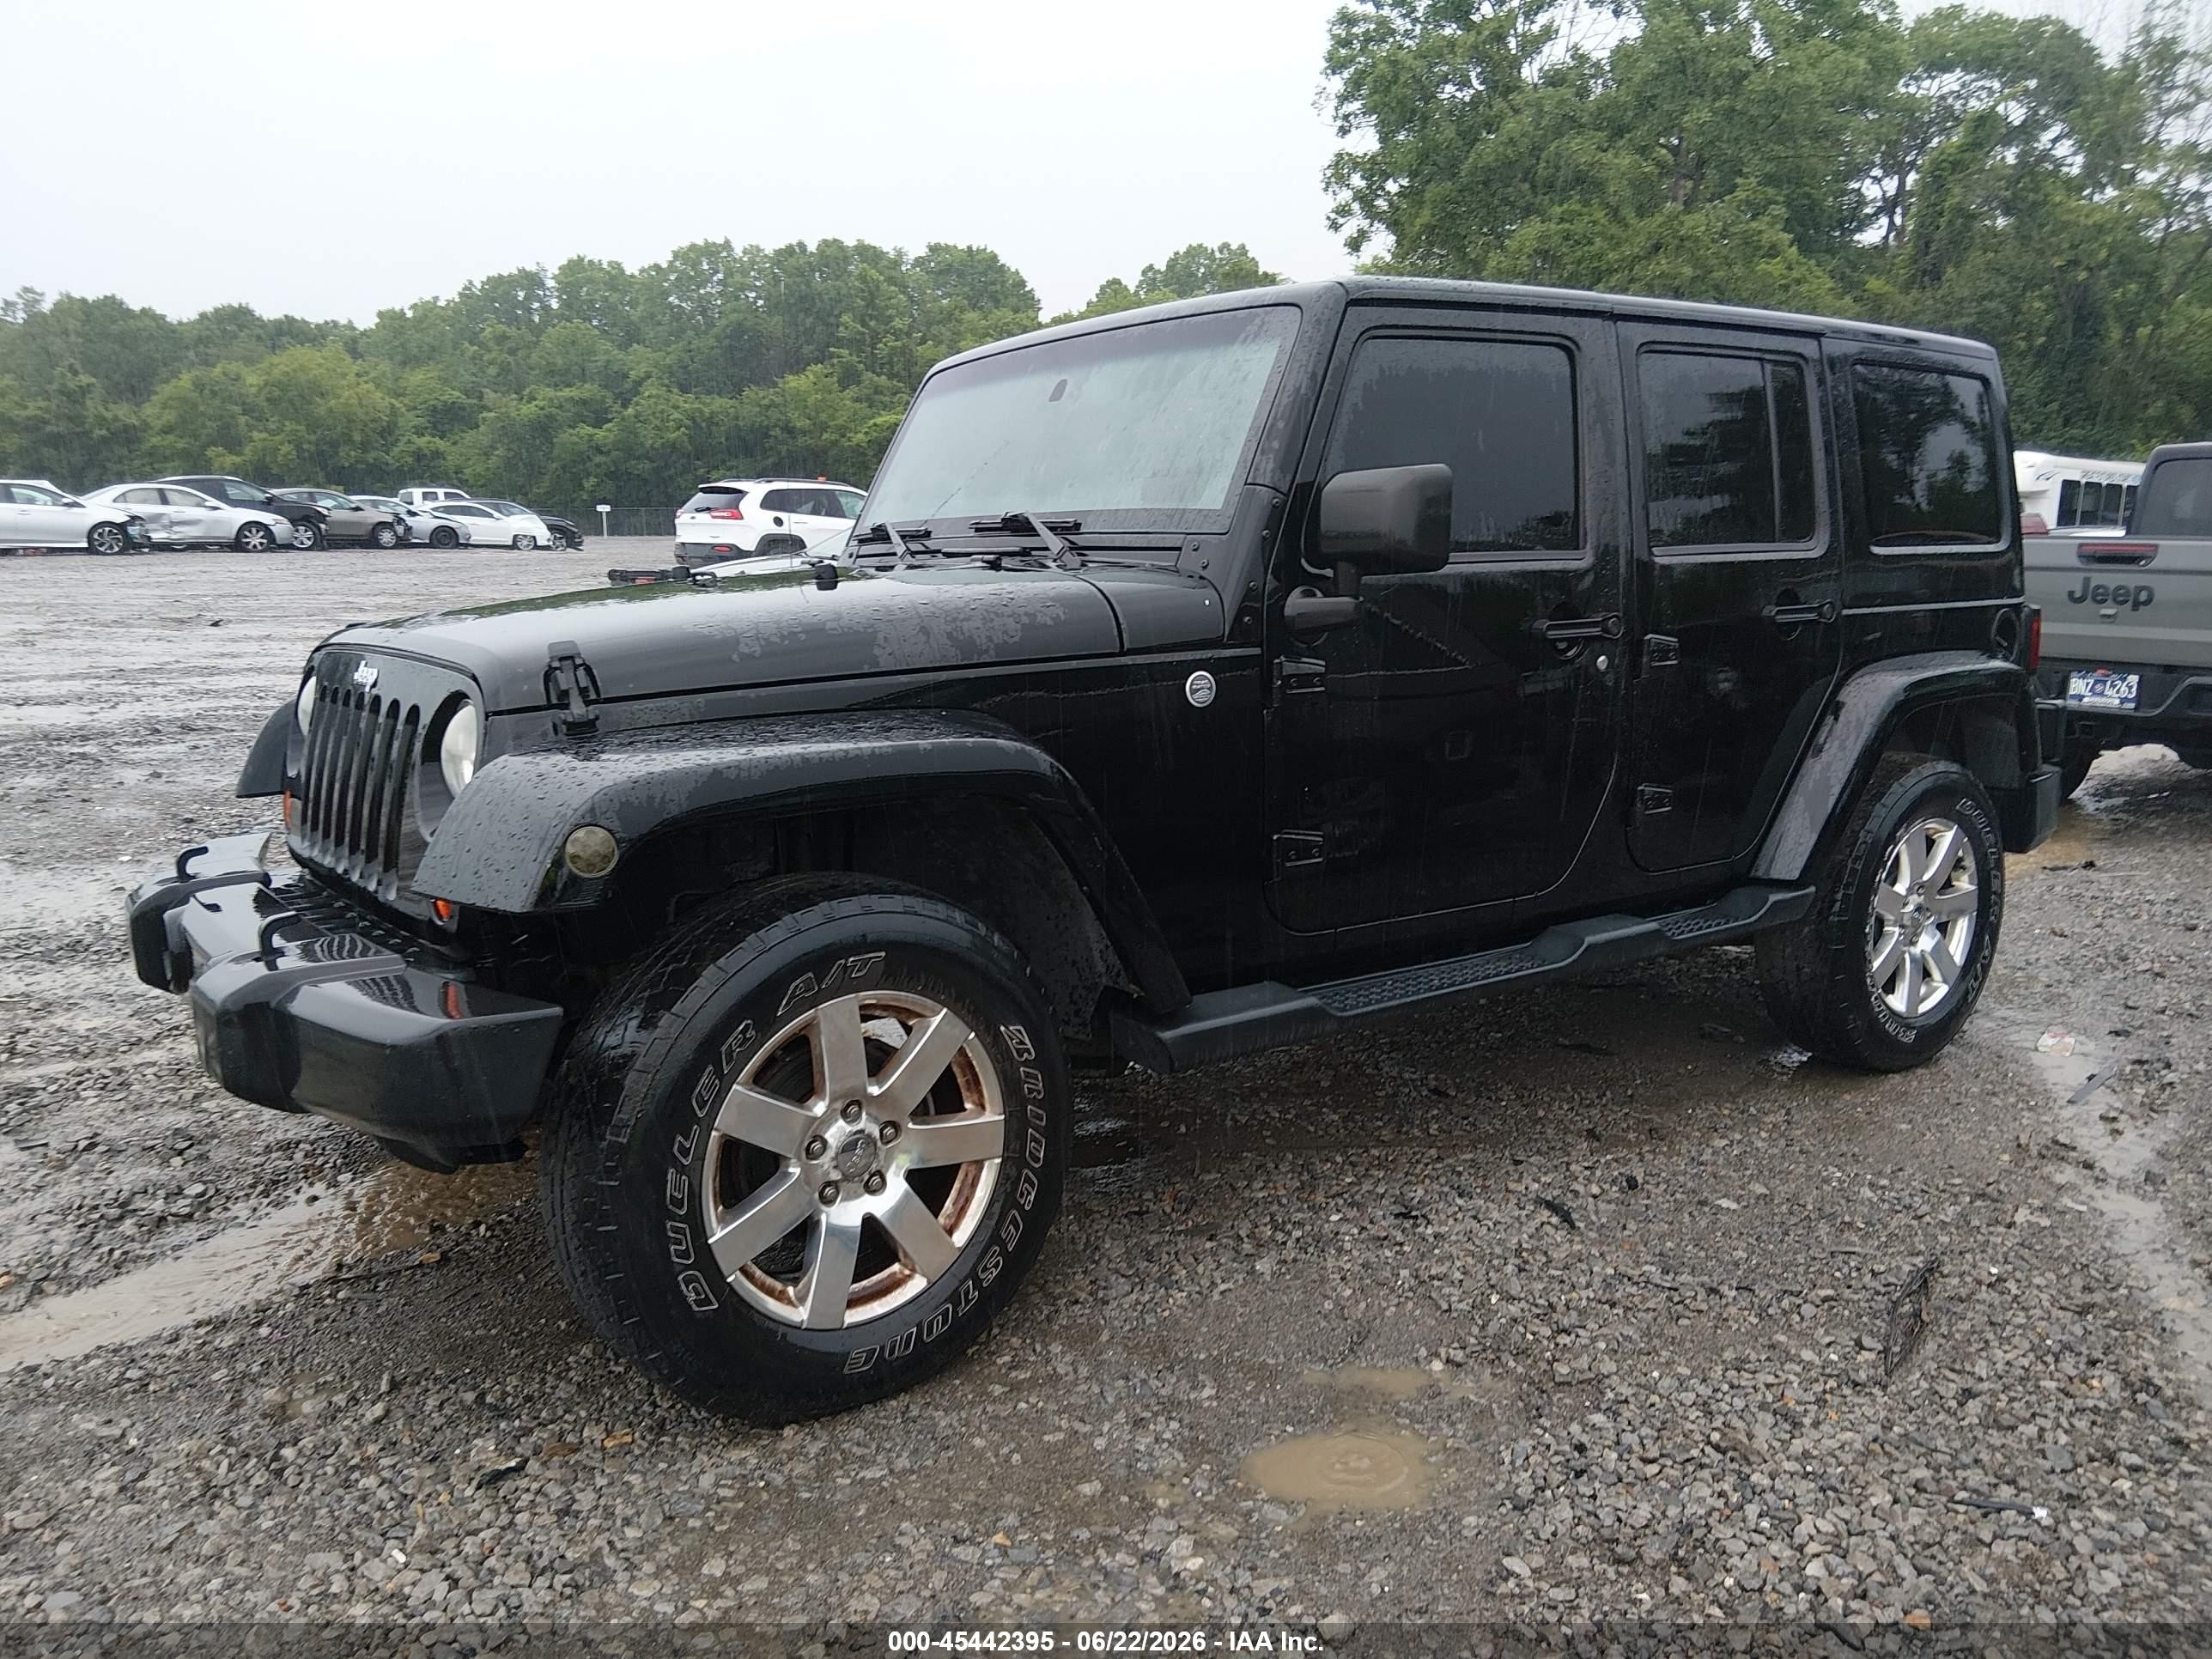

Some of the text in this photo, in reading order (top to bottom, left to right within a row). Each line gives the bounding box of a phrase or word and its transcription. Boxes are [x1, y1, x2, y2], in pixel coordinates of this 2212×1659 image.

[2068, 577, 2154, 611] Jeep
[2104, 679, 2137, 698] 4263
[666, 951, 886, 1312] DUELER A/T
[843, 1024, 1046, 1375] BRIDGESTONE
